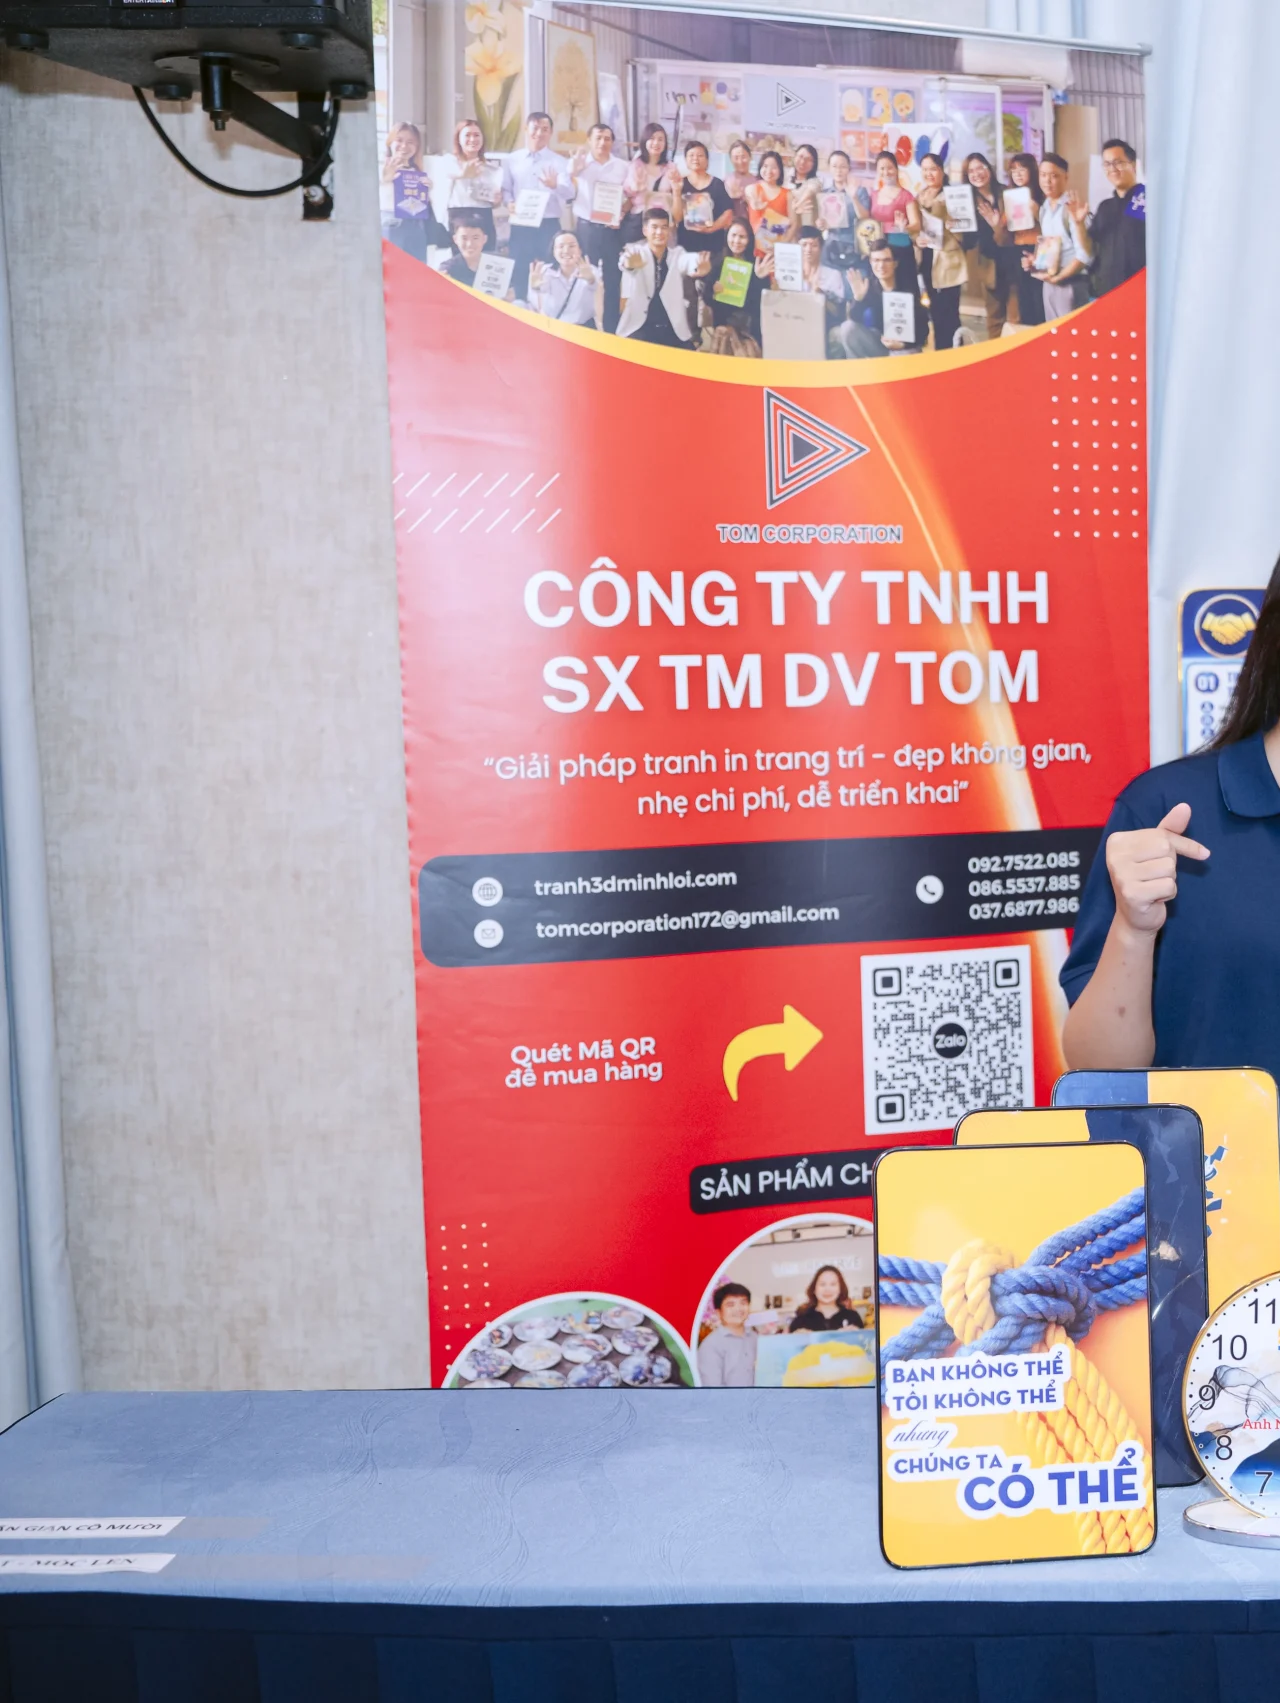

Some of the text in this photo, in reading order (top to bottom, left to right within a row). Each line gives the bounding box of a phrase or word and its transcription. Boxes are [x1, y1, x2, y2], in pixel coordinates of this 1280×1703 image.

[717, 525, 903, 543] TOM CORPORATION
[523, 556, 1049, 628] CÔNG TY TNHH
[542, 649, 1039, 714] SX TM DV TOM
[559, 752, 636, 785] pháp
[643, 749, 717, 775] tranh
[724, 748, 748, 772] in
[755, 748, 829, 776] trang
[837, 745, 865, 769] trí
[894, 744, 945, 773] đẹp
[951, 742, 1026, 770] không
[1032, 739, 1092, 769] gian,
[638, 791, 688, 818] nhẹ
[695, 787, 735, 813] chi
[743, 785, 791, 817] phí,
[797, 780, 831, 808] dễ
[838, 779, 899, 807] triển
[968, 851, 1080, 874] 092.7522.085
[534, 870, 738, 896] tranh3dminhloi.com
[968, 874, 1081, 897] 086.5537.885
[536, 905, 840, 938] tomcorporation172@gmail.com
[969, 897, 1080, 920] 037.6877.986
[510, 1036, 656, 1068] Quét Mã QR
[935, 1033, 967, 1049] Zalo
[544, 1067, 598, 1086] mua
[604, 1061, 663, 1082] hàng
[700, 1168, 751, 1200] SẢN
[758, 1157, 833, 1193] PHẨM
[1248, 1298, 1276, 1324] 11
[1212, 1334, 1247, 1360] 10
[892, 1351, 1064, 1387] BẠN KHÔNG THỂ
[892, 1379, 1057, 1411] TÔI KHÔNG THỂ
[1199, 1384, 1216, 1410] 9
[1242, 1418, 1271, 1430] Anh
[1215, 1435, 1232, 1460] 8
[894, 1452, 1002, 1474] CHÚNG TA
[964, 1447, 1139, 1511] CÓ THỂ
[1255, 1471, 1273, 1496] 7
